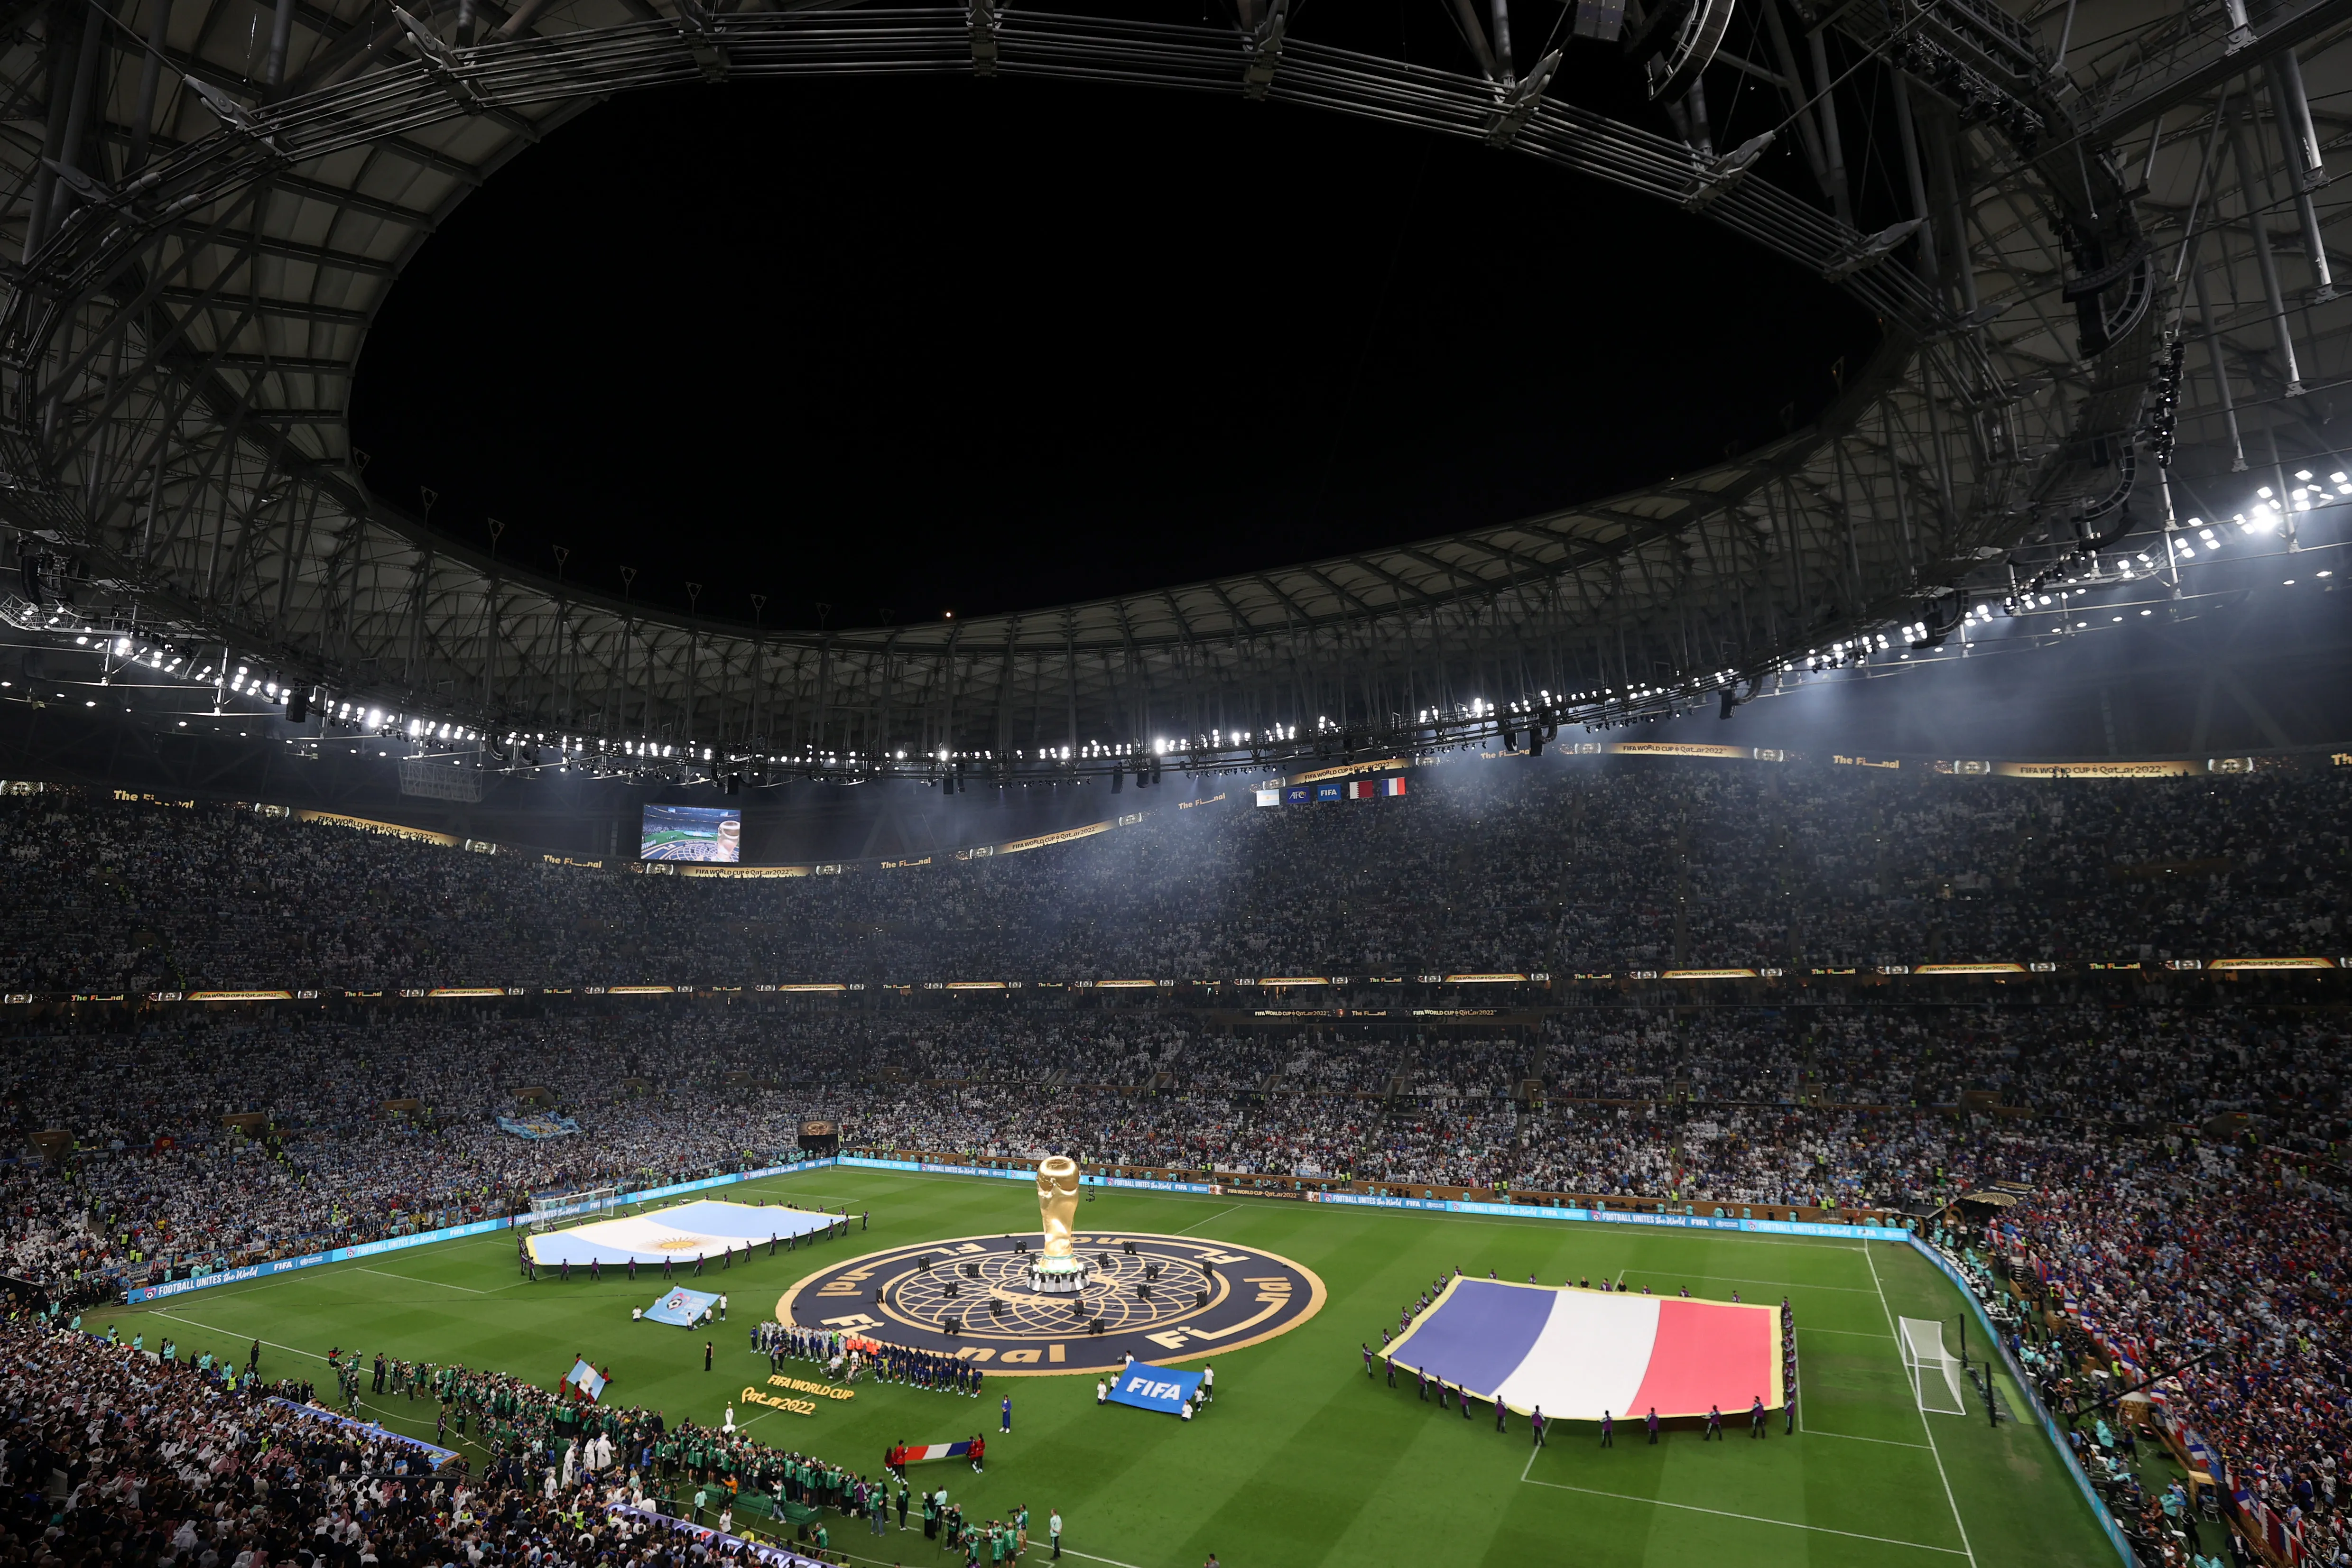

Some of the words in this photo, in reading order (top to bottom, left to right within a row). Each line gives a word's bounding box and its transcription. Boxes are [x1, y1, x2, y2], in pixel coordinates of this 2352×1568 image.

[1833, 755, 1853, 765] The
[1305, 772, 1316, 780] FIFA
[114, 790, 138, 801] The
[1289, 791, 1306, 800] AFC
[1178, 802, 1193, 810] The
[335, 818, 363, 828] WORLD
[544, 854, 561, 864] The
[750, 1170, 768, 1178] FOOTBALL
[1333, 1195, 1357, 1203] FOOTBALL
[1358, 1196, 1375, 1204] UNITES
[1386, 1198, 1402, 1207] World
[516, 1211, 540, 1224] FOOTBALL
[541, 1210, 556, 1219] UNITES
[566, 1206, 580, 1214] World
[1462, 1204, 1489, 1212] FOOTBALL
[1490, 1206, 1508, 1214] UNITES
[1519, 1208, 1537, 1216] World
[1603, 1213, 1632, 1222] FOOTBALL
[1633, 1215, 1654, 1223] UNITES
[1656, 1216, 1666, 1224] the
[1667, 1216, 1685, 1226] World
[1759, 1222, 1791, 1232] FOOTBALL
[1795, 1224, 1815, 1233] UNITES
[1818, 1226, 1828, 1234] the
[1830, 1227, 1851, 1236] World
[357, 1244, 387, 1255] FOOTBALL
[389, 1239, 408, 1248] UNITES
[420, 1232, 437, 1242] World
[274, 1261, 292, 1271] FIFA
[158, 1280, 194, 1296] FOOTBALL
[197, 1274, 221, 1287] UNITES
[222, 1272, 235, 1282] the
[236, 1266, 259, 1280] World
[767, 1374, 791, 1388] FIFA
[791, 1379, 831, 1395] WORLD
[829, 1388, 854, 1400] CUP
[1126, 1376, 1181, 1400] FIFA
[741, 1386, 816, 1415] Qatar2022
